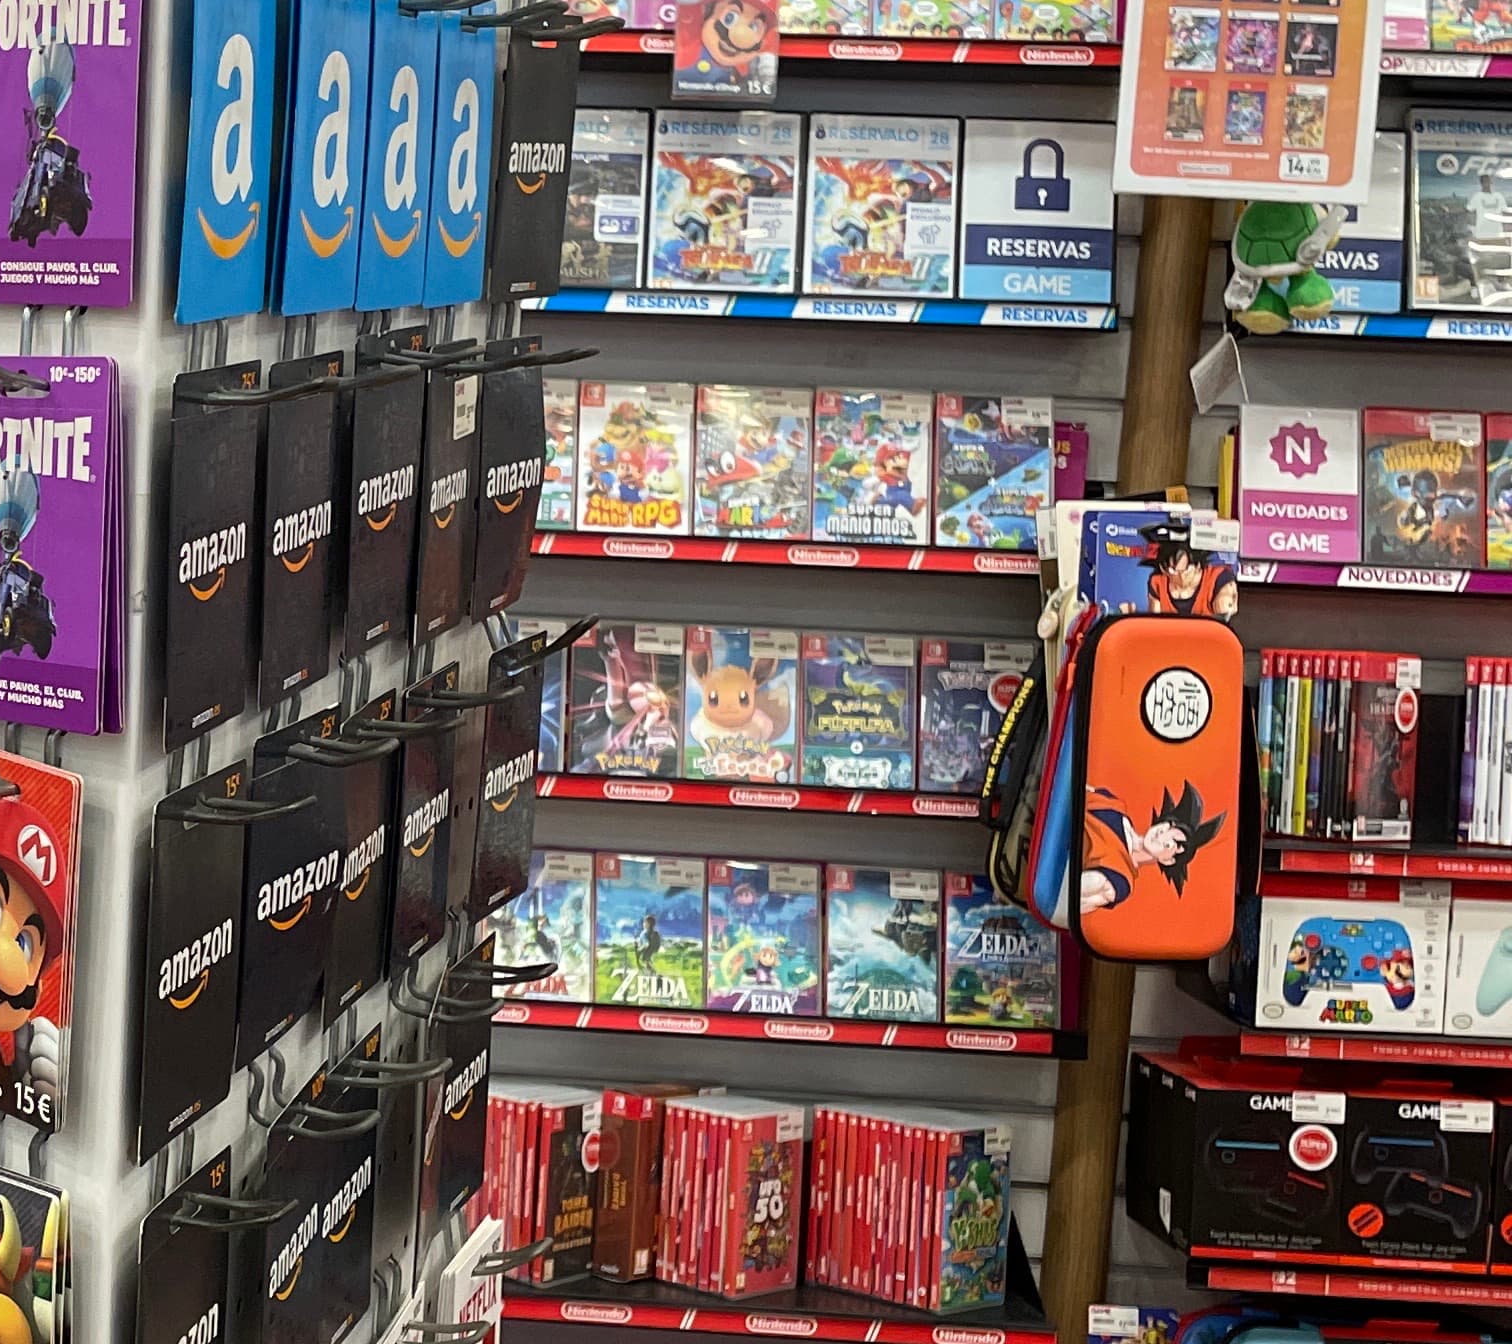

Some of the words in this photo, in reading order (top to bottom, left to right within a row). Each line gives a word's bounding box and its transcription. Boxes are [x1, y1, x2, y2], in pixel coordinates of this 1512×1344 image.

[212, 34, 254, 206] a
[313, 50, 351, 208] a
[386, 65, 419, 211] a
[509, 140, 565, 175] amazon
[988, 237, 1091, 259] RESERVAS
[45, 273, 77, 285] MUCHO
[1003, 272, 1071, 296] GAME
[626, 294, 709, 311] RESERVAS
[813, 300, 897, 317] RESERVAS
[358, 464, 414, 516] amazon
[430, 468, 467, 513] amazon
[487, 456, 541, 500] amazon
[273, 499, 331, 558] amazon
[633, 500, 678, 524] RPG
[1251, 503, 1348, 522] NOVEDADES
[178, 522, 246, 584] amazon
[1269, 533, 1330, 553] GAME
[1349, 569, 1453, 588] NOVEDADES
[484, 749, 534, 801] amazon
[403, 787, 449, 848] amazon
[257, 849, 339, 922] amazon
[158, 918, 233, 1000] amazon
[956, 928, 1028, 959] ZELDA
[610, 969, 690, 1003] ZELDA
[842, 983, 920, 1015] ZELDA
[444, 1049, 487, 1115] amazon
[321, 1156, 372, 1239] amazon
[268, 1200, 319, 1299] amazon
